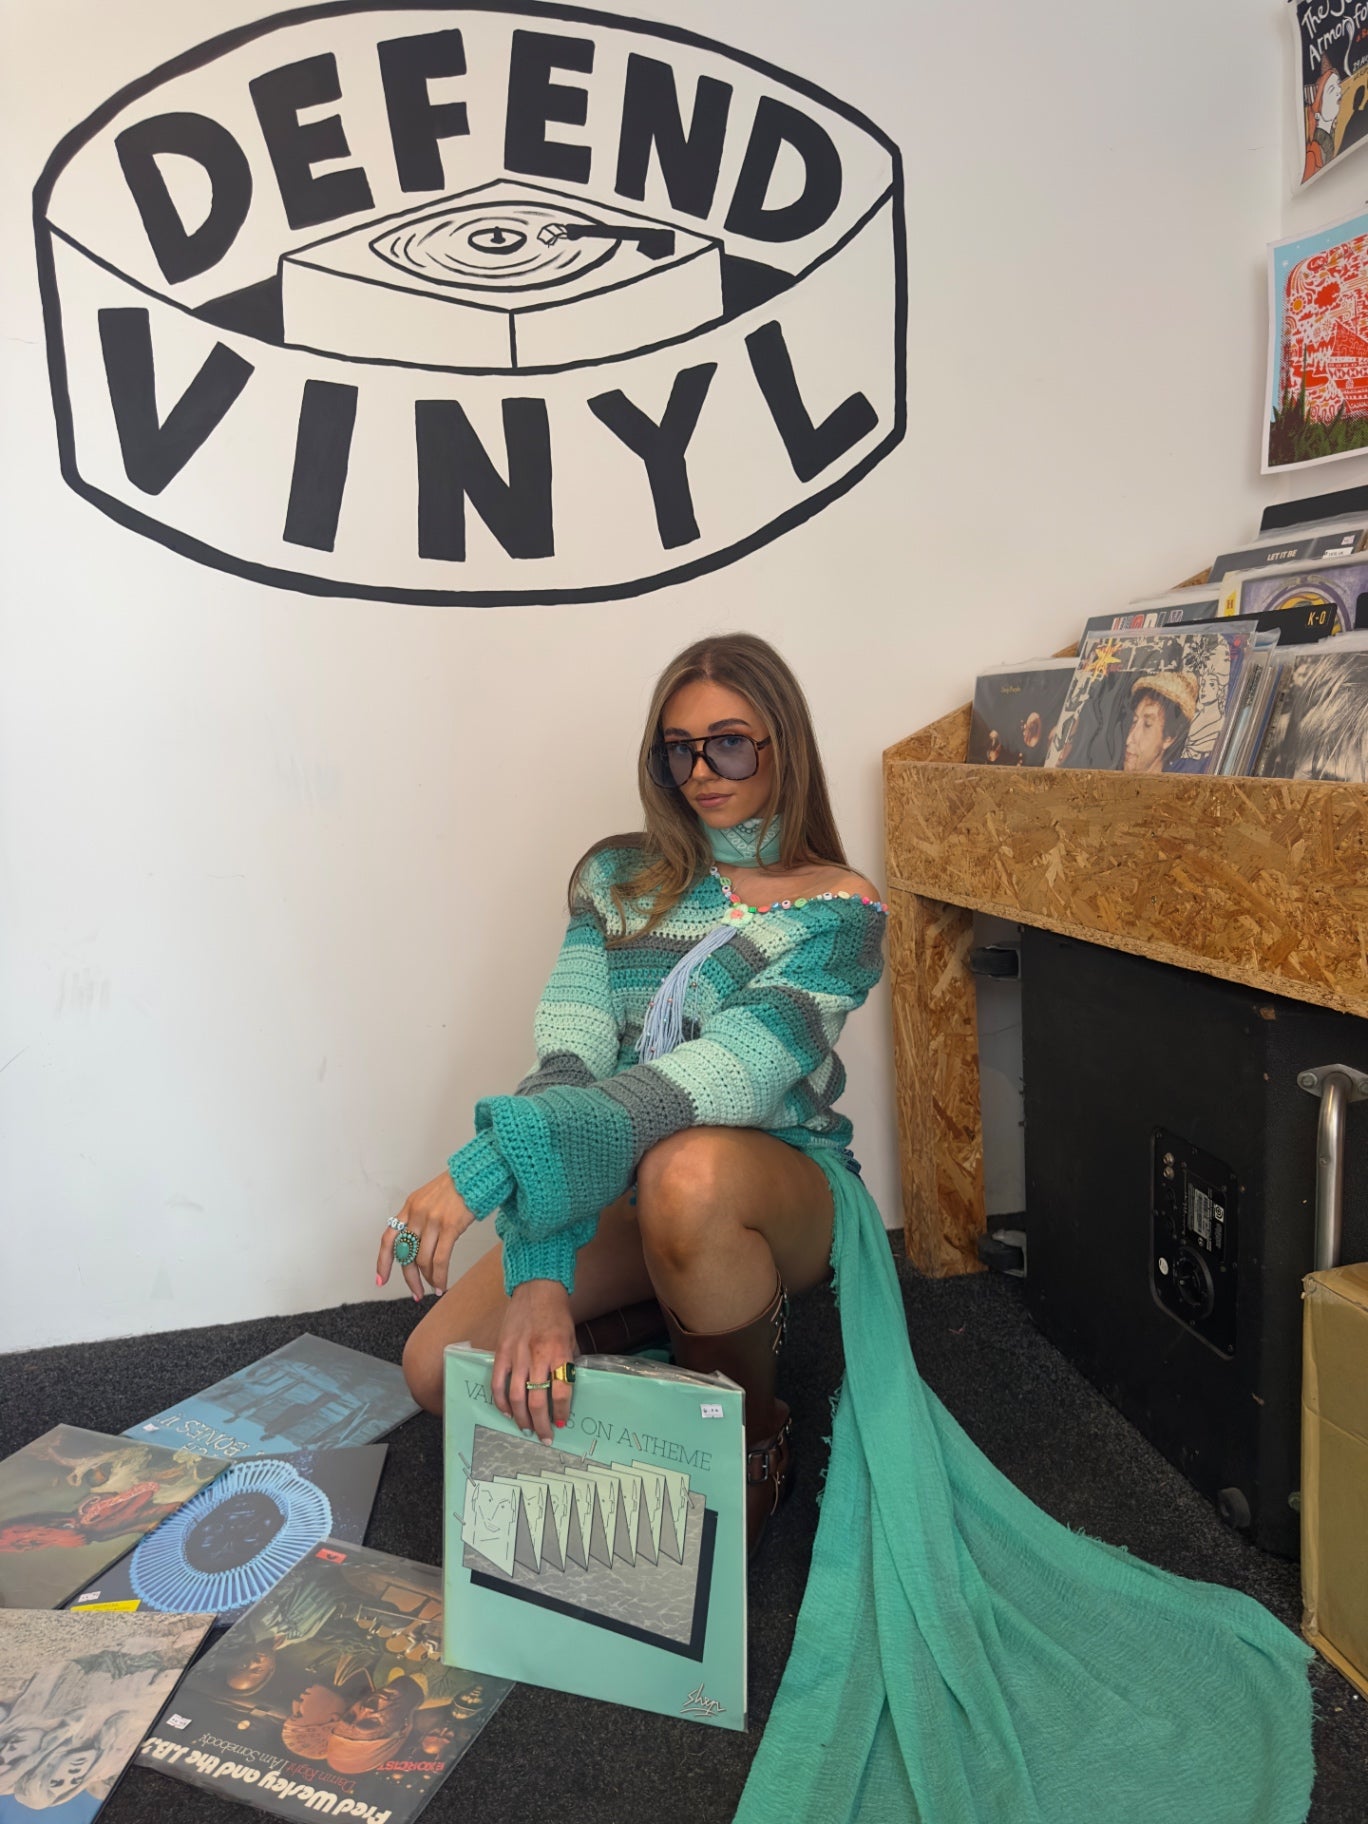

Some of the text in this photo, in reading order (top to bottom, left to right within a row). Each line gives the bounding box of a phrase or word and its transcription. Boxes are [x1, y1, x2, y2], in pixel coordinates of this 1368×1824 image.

[1301, 0, 1330, 39] The
[115, 29, 842, 285] DEFEND
[98, 308, 879, 563] VINYL
[1267, 553, 1279, 561] LET
[1288, 549, 1298, 558] BE
[176, 1420, 249, 1457] BONES
[580, 1416, 713, 1472] ON A THEME
[184, 1750, 221, 1775] the
[212, 1761, 261, 1784] and
[259, 1749, 282, 1769] Am
[376, 1760, 445, 1772] EXORCIST
[257, 1769, 338, 1814] Wesley
[331, 1797, 393, 1824] Fred
